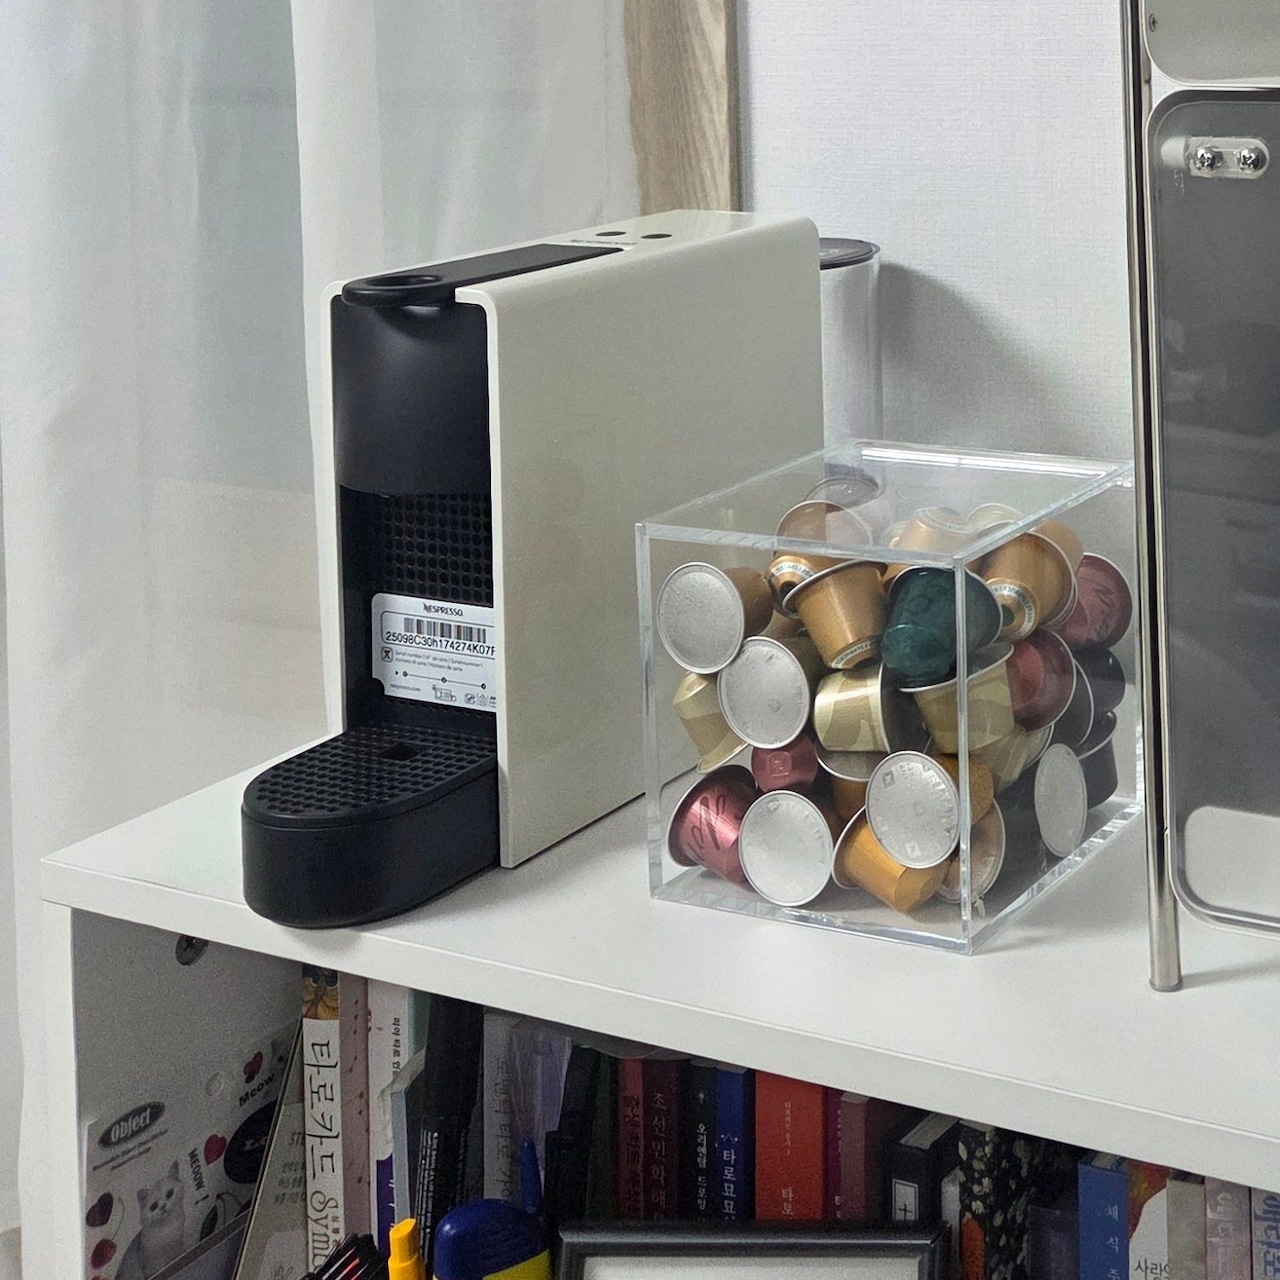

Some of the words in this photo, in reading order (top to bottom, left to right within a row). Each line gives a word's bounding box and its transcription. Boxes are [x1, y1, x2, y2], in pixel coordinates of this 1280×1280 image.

[422, 602, 464, 617] NESPRESSO
[304, 1040, 340, 1181] 타로카드
[721, 1148, 737, 1218] 타로묘묘
[781, 1187, 796, 1219] 타로
[308, 1190, 339, 1274] Symb
